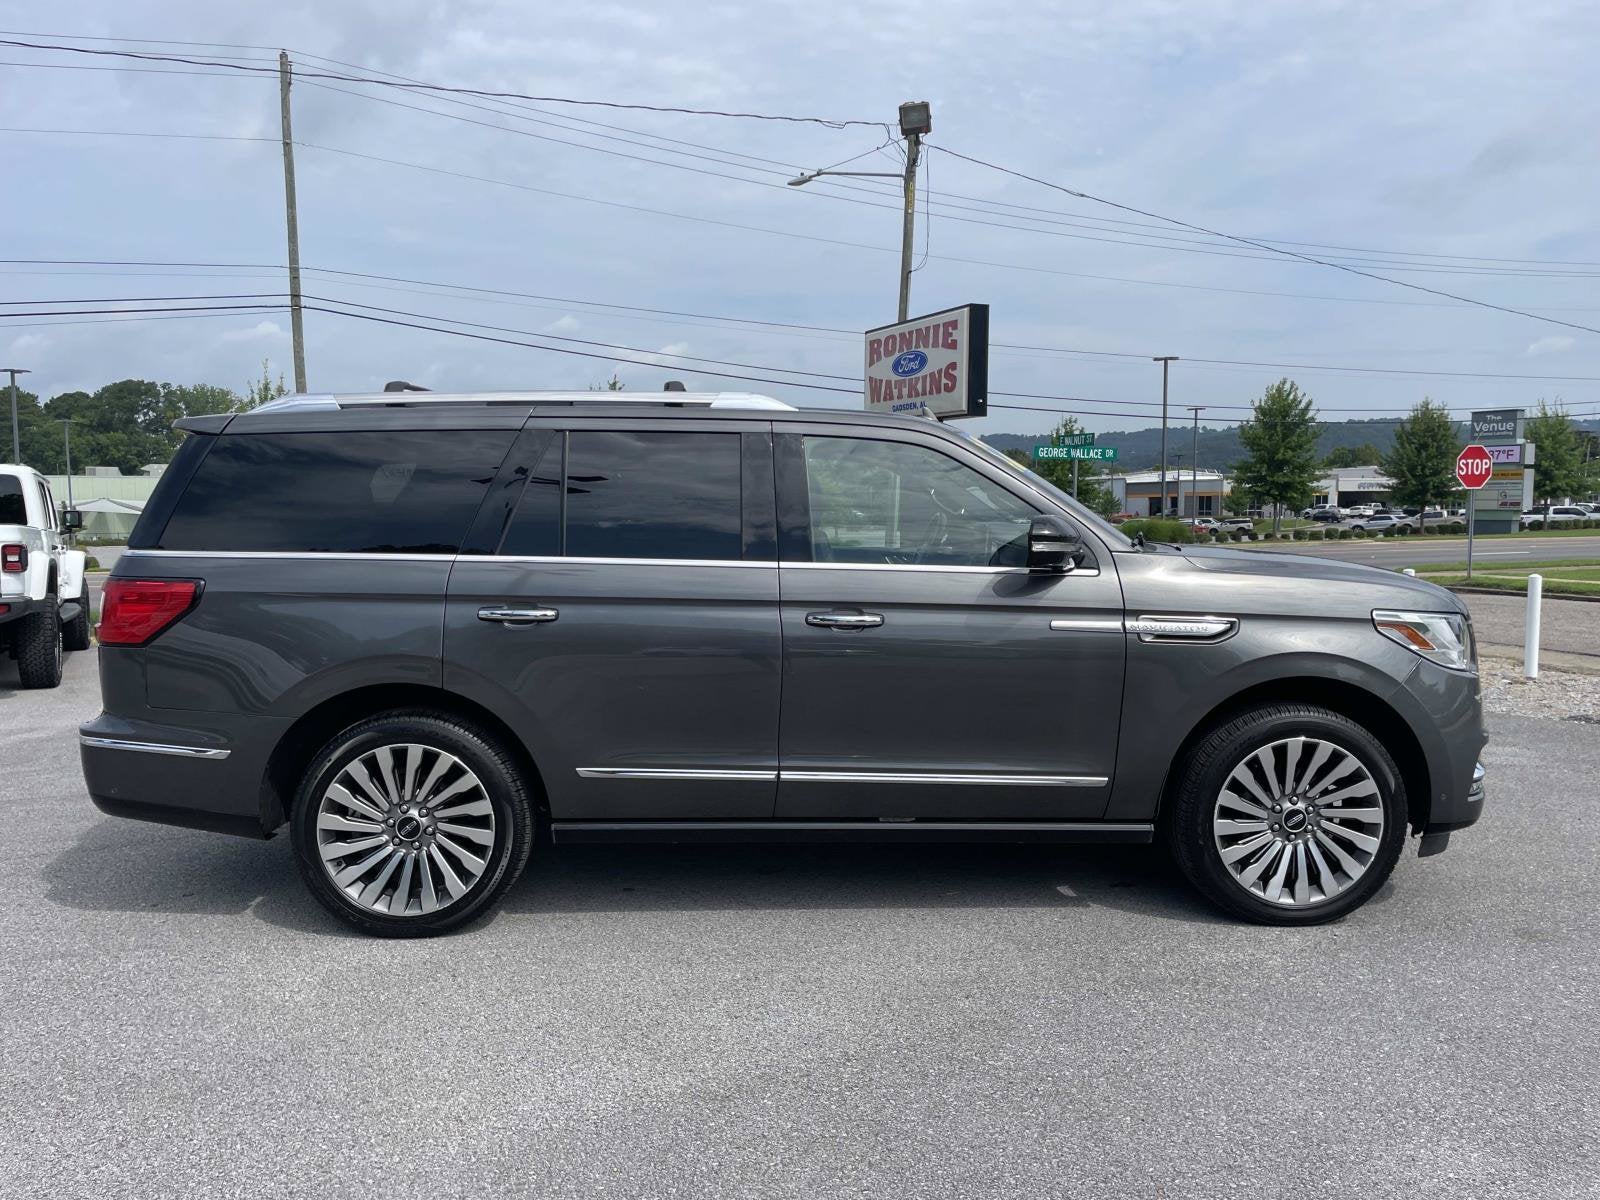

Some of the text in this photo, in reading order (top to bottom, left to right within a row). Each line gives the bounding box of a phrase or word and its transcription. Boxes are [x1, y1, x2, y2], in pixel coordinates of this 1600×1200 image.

[868, 319, 959, 368] RONNIE
[898, 353, 922, 373] Ford
[868, 361, 958, 404] WATKINS
[1473, 422, 1515, 431] Venue
[1038, 447, 1114, 459] GEORGE WALLACE DR
[1459, 459, 1490, 475] STOP
[1128, 624, 1209, 633] NAVIGATOR
